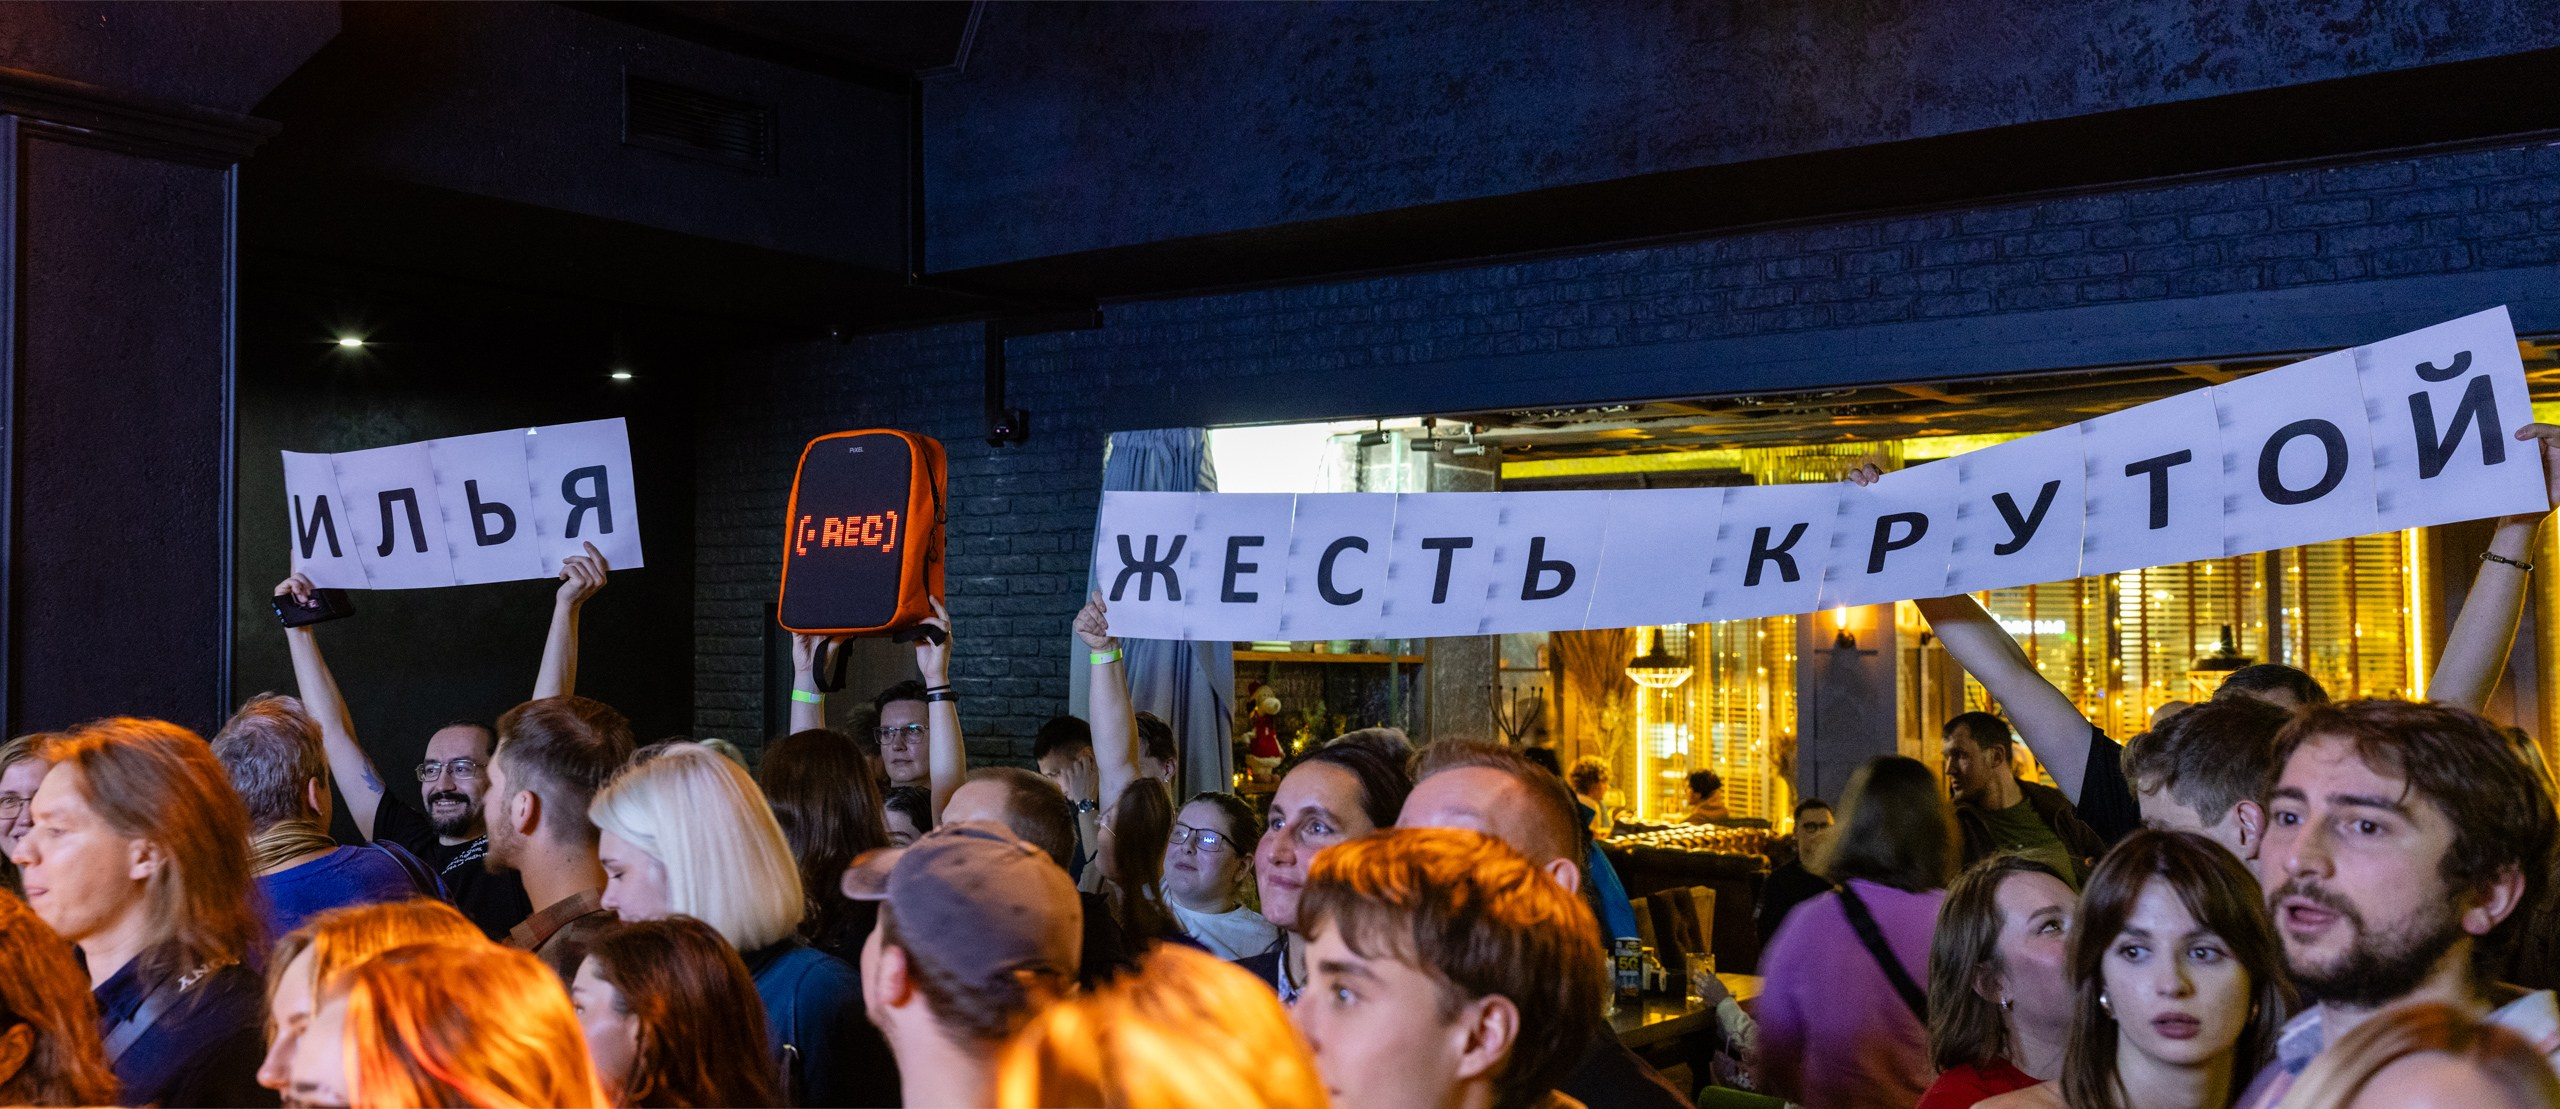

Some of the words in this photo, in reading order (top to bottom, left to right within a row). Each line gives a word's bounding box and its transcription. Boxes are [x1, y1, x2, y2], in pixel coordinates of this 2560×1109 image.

[294, 464, 613, 560] ИЛЬЯ
[1108, 534, 1576, 606] ЖЕСТЬ
[1743, 350, 2507, 588] КРУТОЙ
